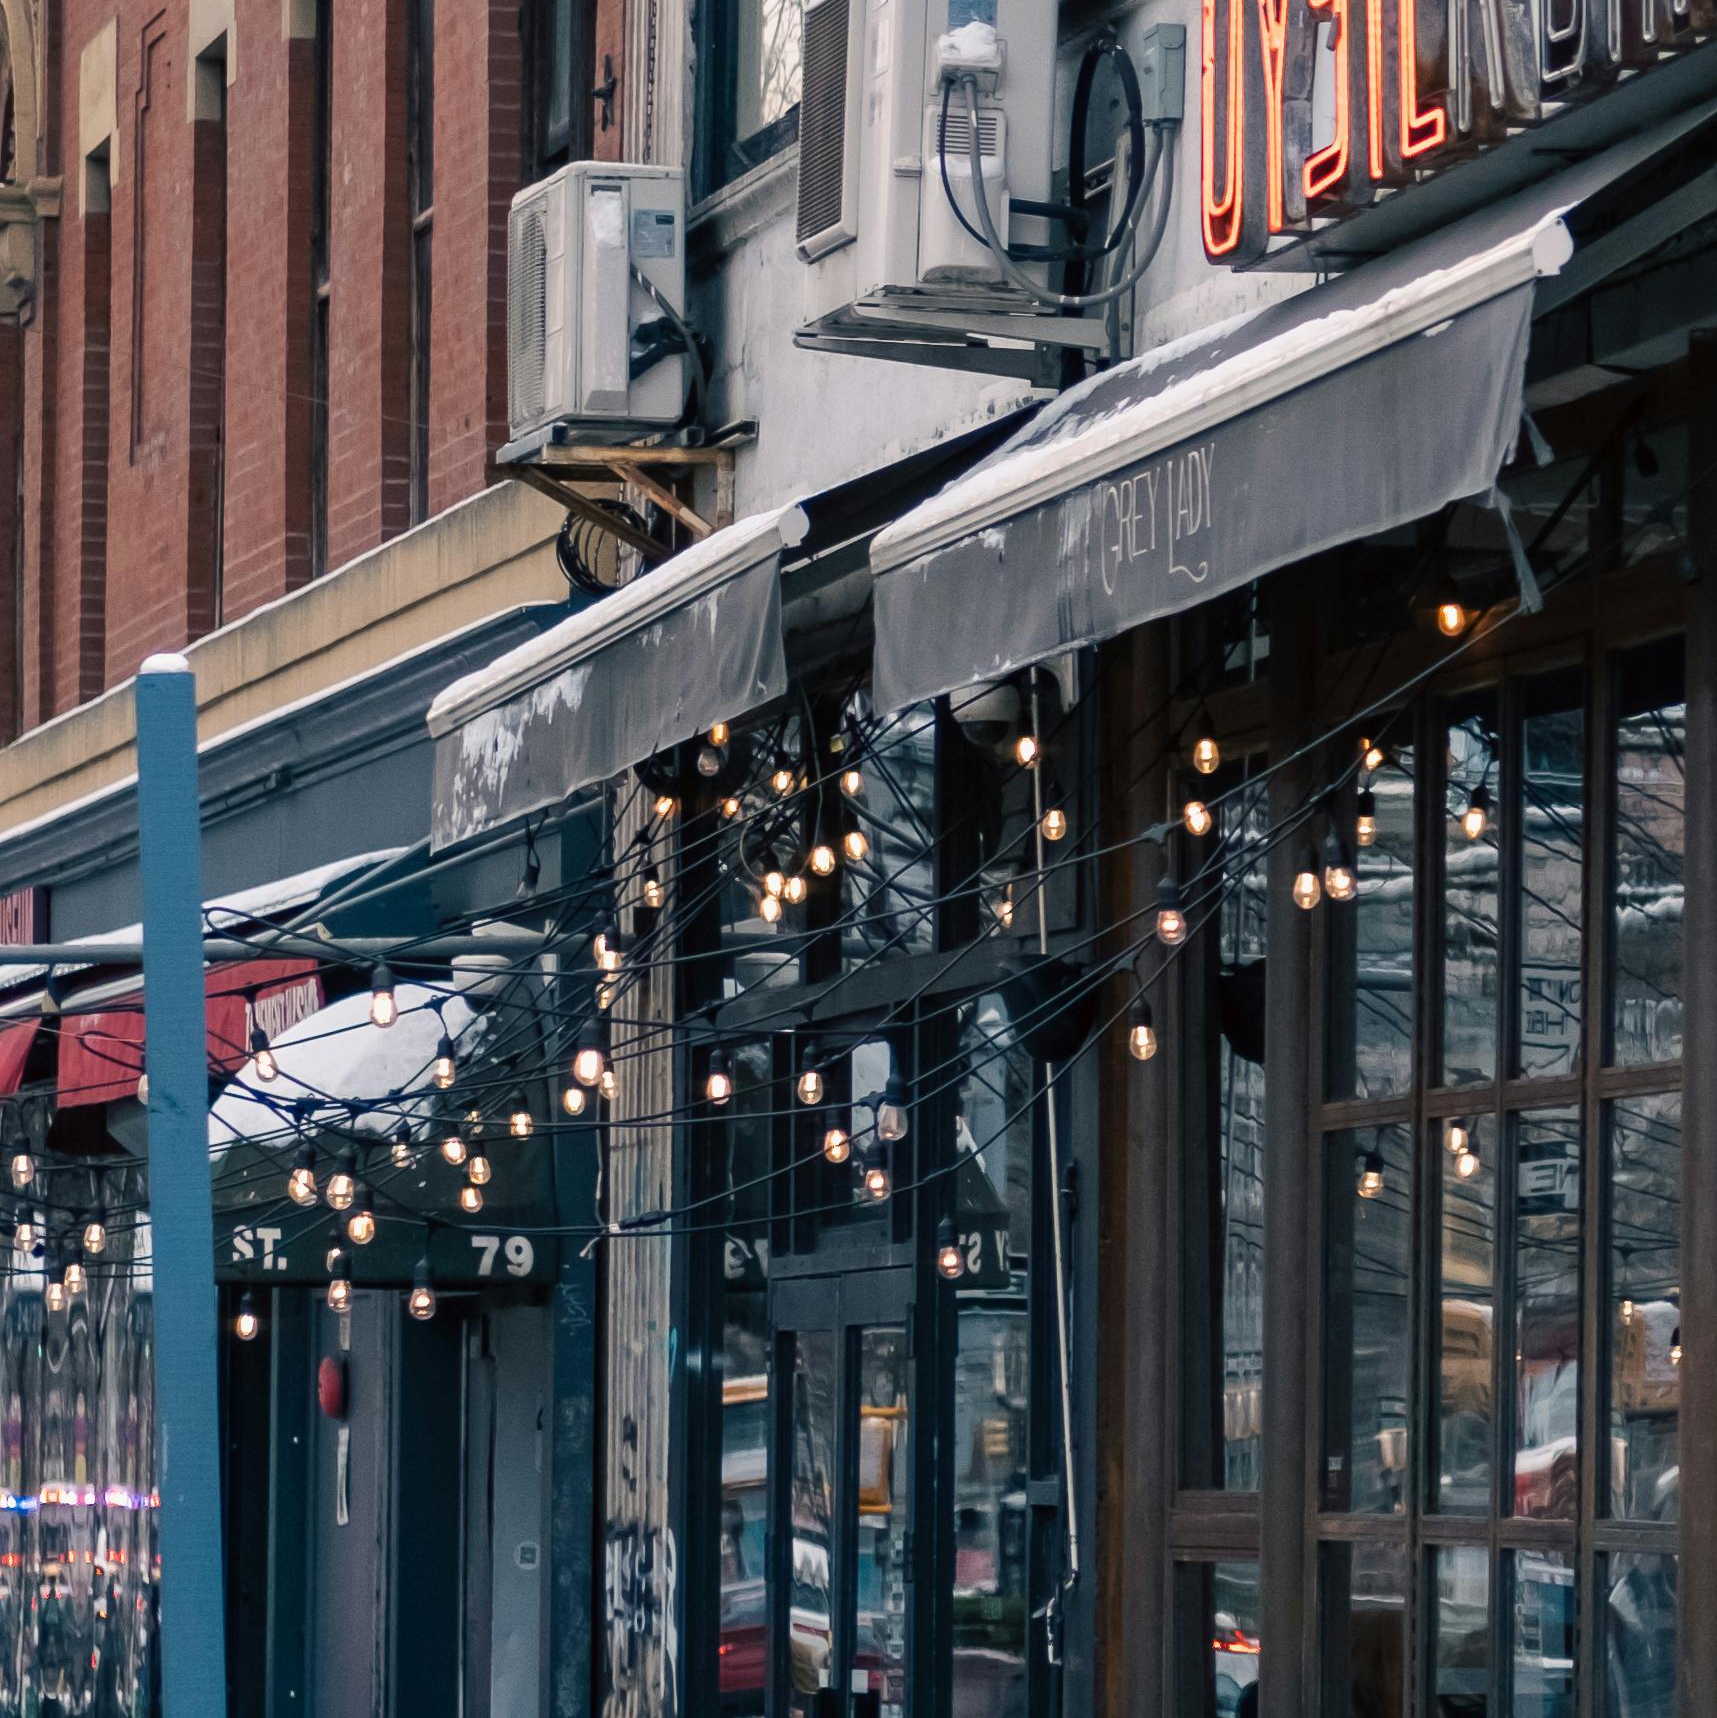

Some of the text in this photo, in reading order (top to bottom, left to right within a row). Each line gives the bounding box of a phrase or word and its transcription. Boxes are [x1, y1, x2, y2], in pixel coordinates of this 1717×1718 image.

[1100, 441, 1217, 596] GREY LADY
[471, 1235, 534, 1277] 79
